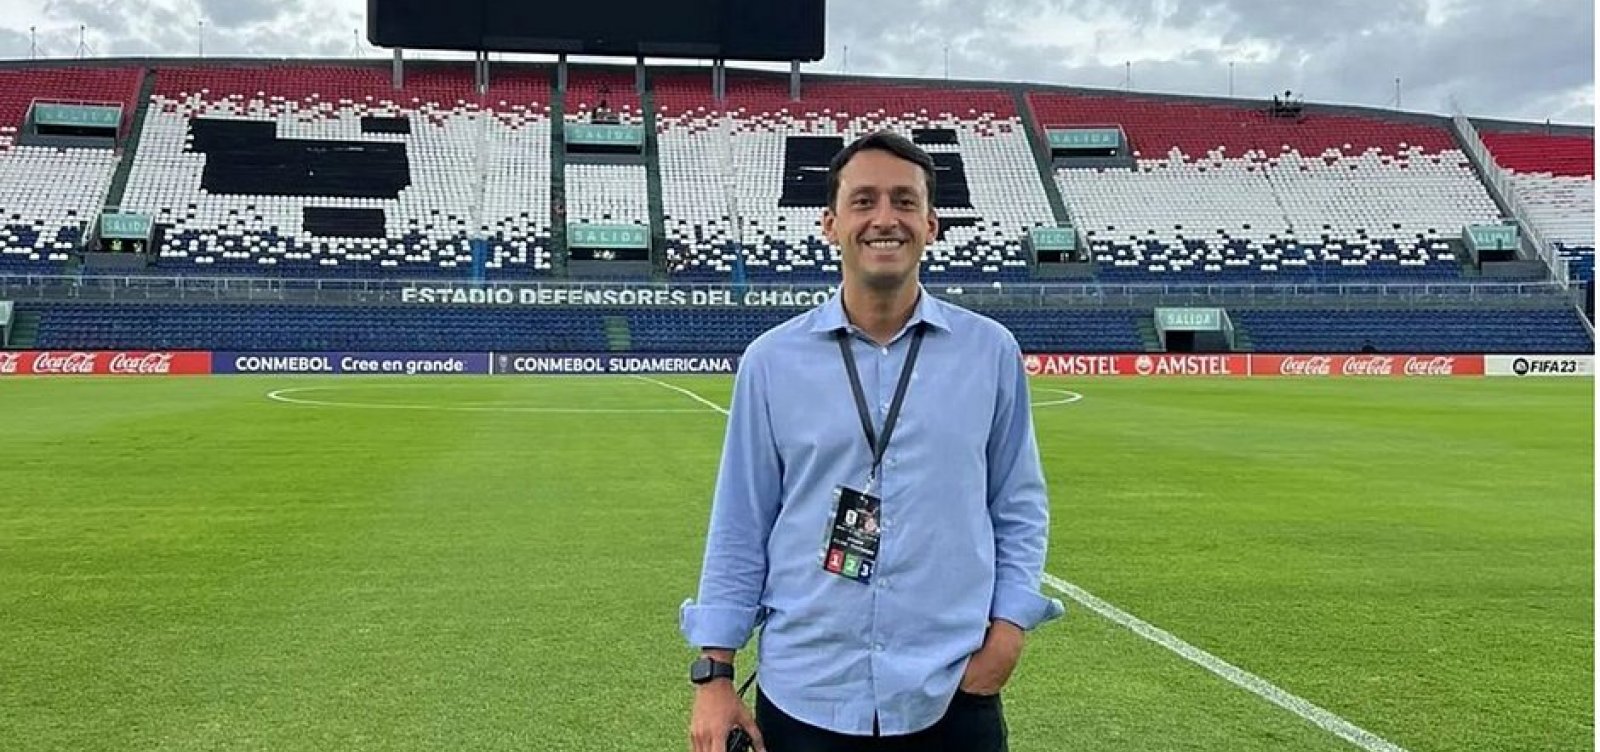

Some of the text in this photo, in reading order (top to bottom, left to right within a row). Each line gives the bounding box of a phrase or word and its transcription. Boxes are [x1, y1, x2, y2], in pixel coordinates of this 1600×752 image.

[574, 230, 643, 242] SALIDA
[401, 287, 828, 306] ESTADIO DEFENSORES DEL CHACO
[1166, 313, 1211, 325] SALIDA
[235, 356, 464, 375] CONMEBOL Cree en grande
[513, 357, 733, 372] CONMEBOL SUDAMERICANA
[1043, 355, 1119, 374] AMSTEL
[1155, 355, 1230, 374] AMSTEL
